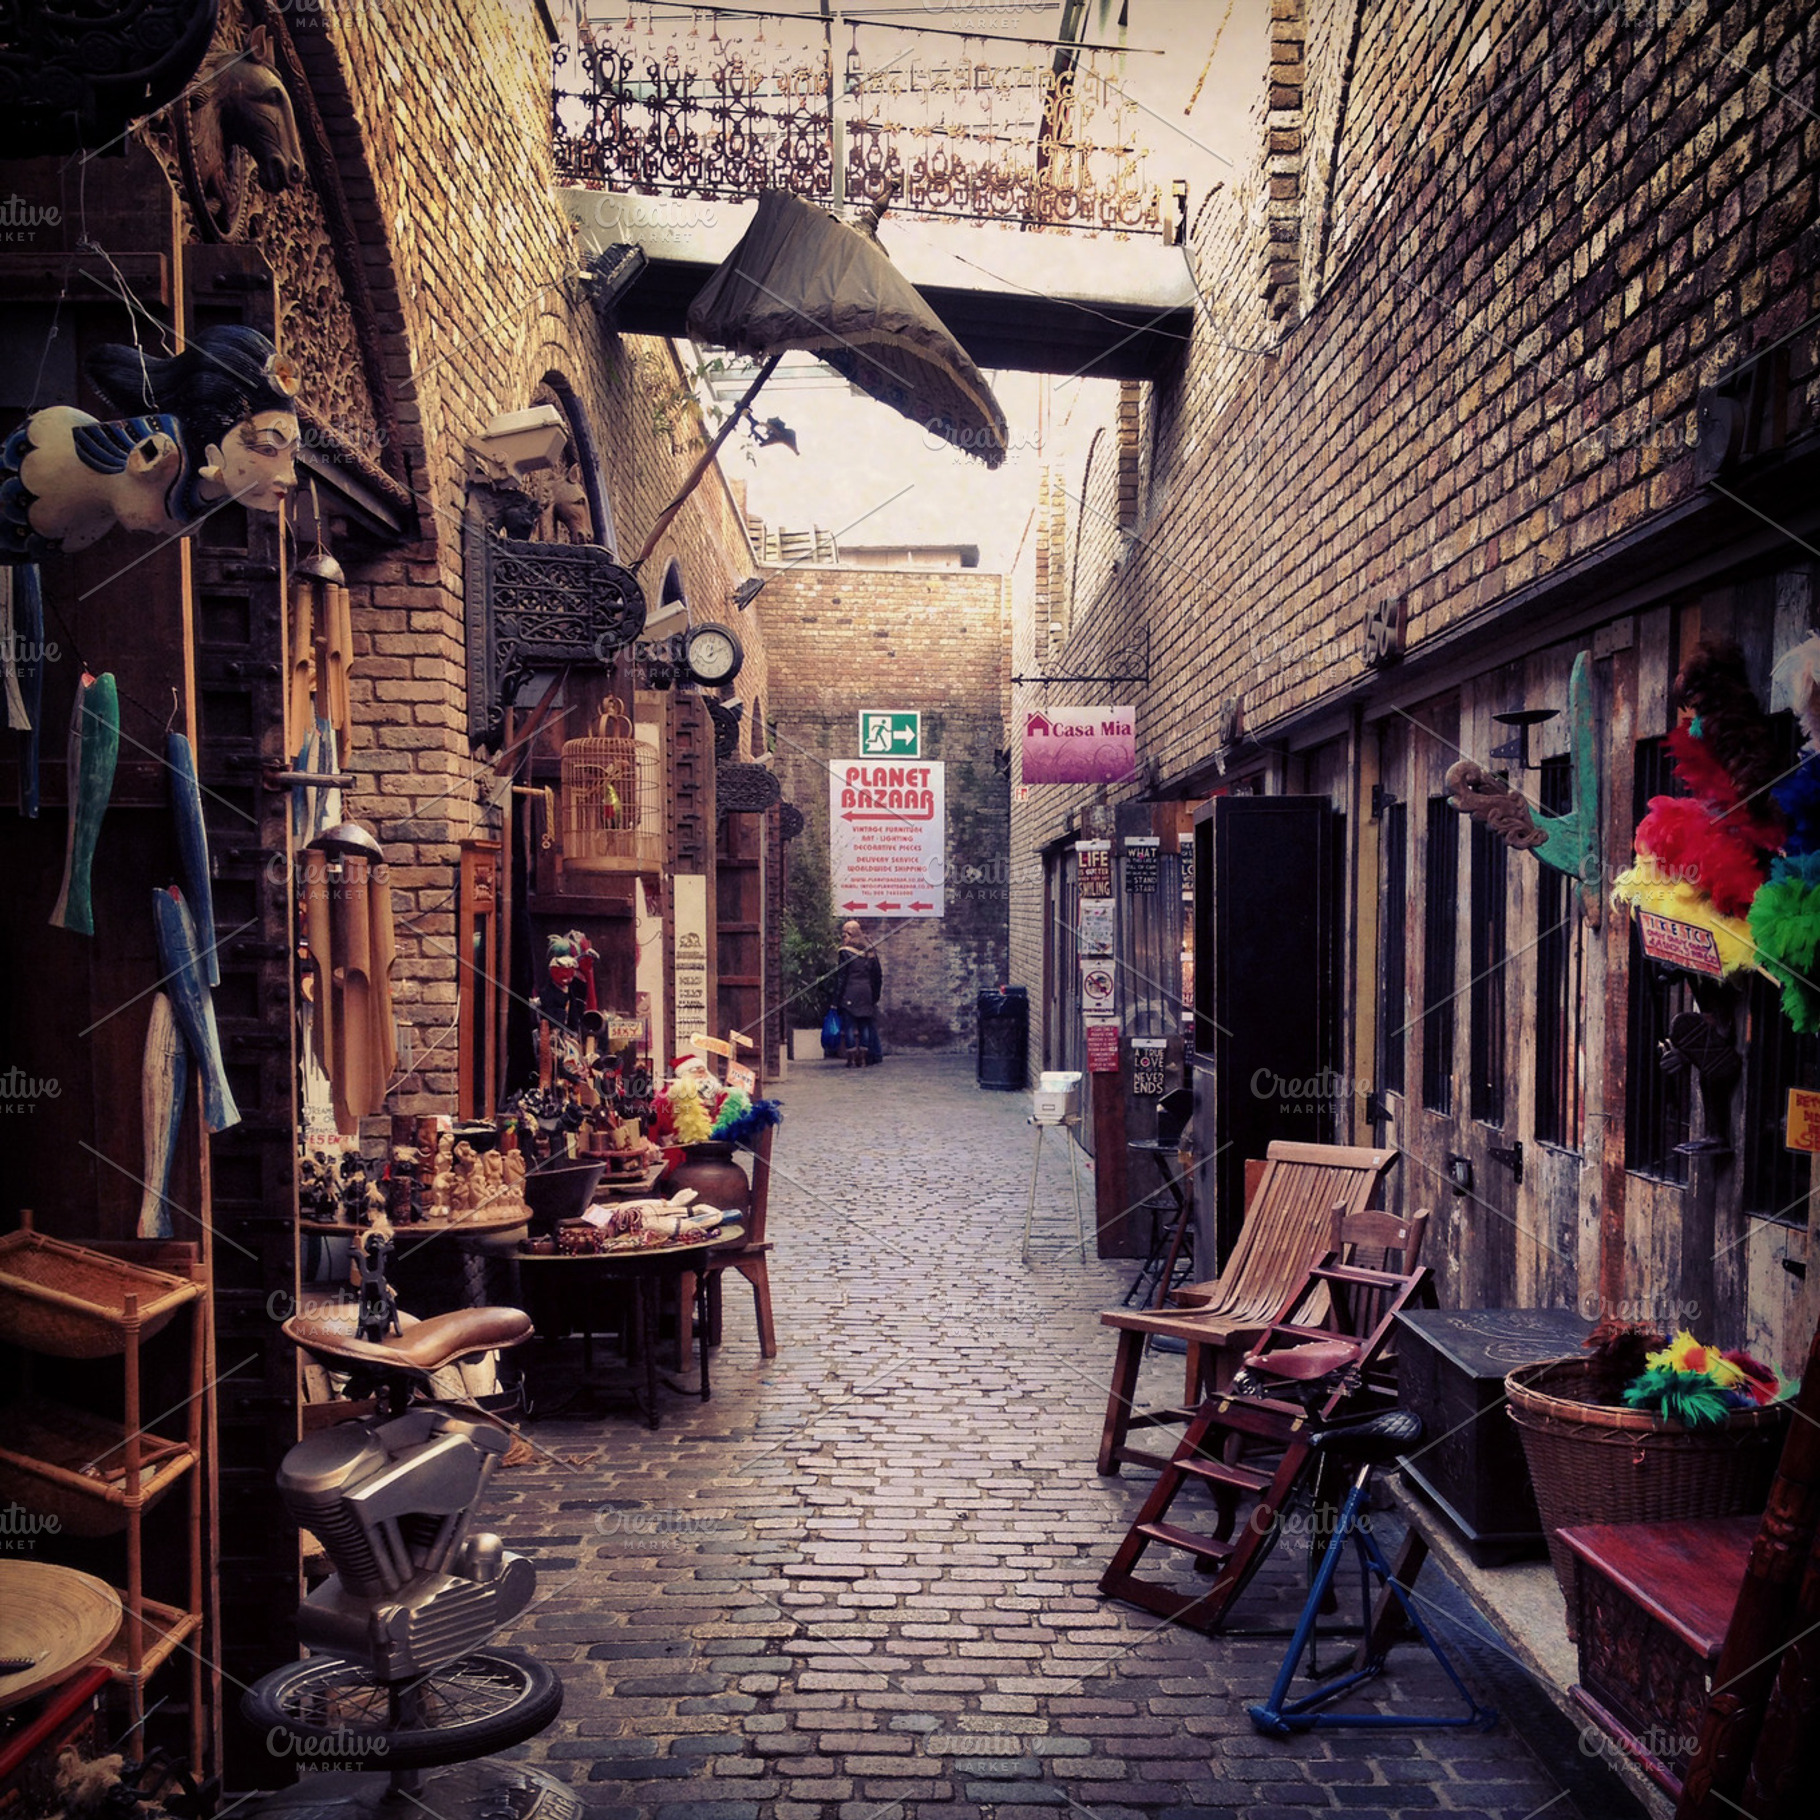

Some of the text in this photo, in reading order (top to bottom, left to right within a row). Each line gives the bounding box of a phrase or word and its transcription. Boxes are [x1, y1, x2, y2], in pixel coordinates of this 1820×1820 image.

[1053, 721, 1132, 738] Casa Mia
[846, 766, 930, 788] PLANET
[842, 788, 934, 809] BAZAAR
[1079, 851, 1108, 867] LIFE
[1128, 848, 1157, 858] WHAT
[1135, 1057, 1164, 1068] LOVE
[1134, 1072, 1164, 1082] NEVER
[1134, 1082, 1164, 1094] ENDS
